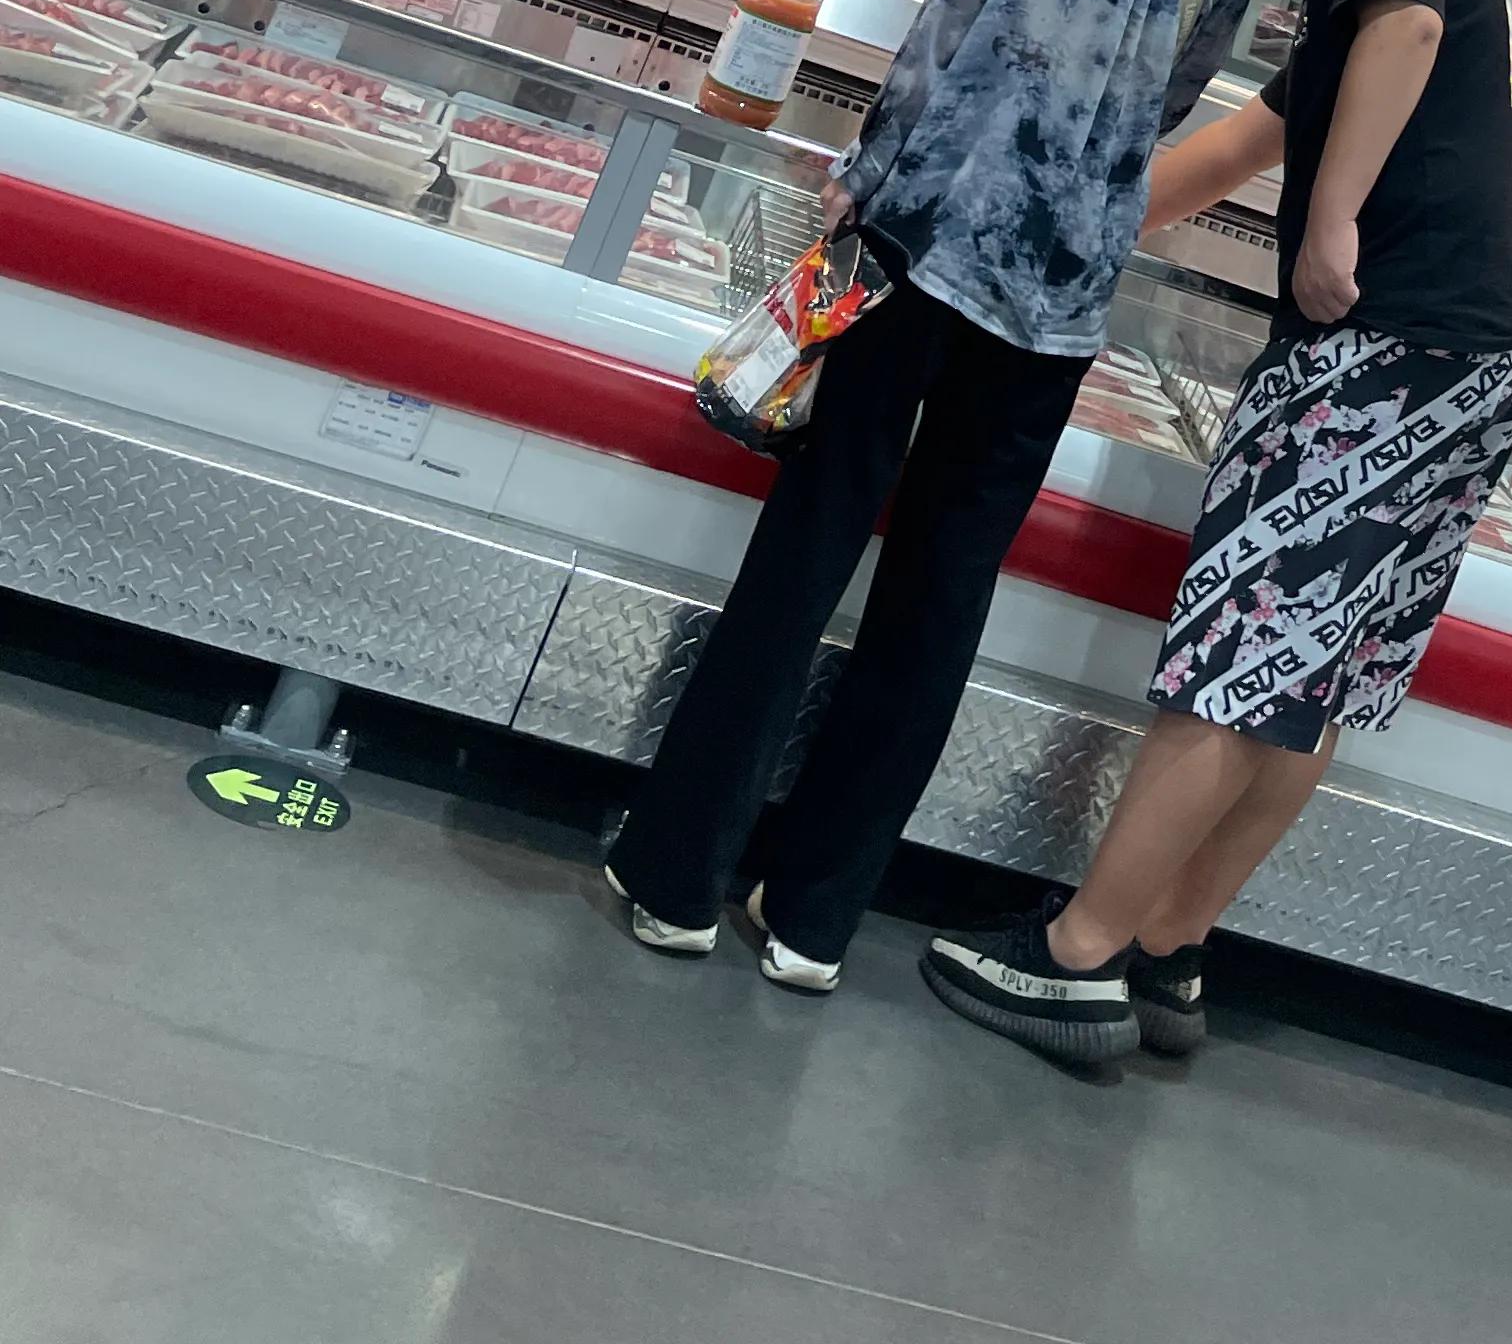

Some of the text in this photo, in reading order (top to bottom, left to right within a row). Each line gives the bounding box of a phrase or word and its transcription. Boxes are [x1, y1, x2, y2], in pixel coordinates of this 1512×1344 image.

[276, 778, 318, 828] 安全出口
[312, 796, 341, 827] EXIT
